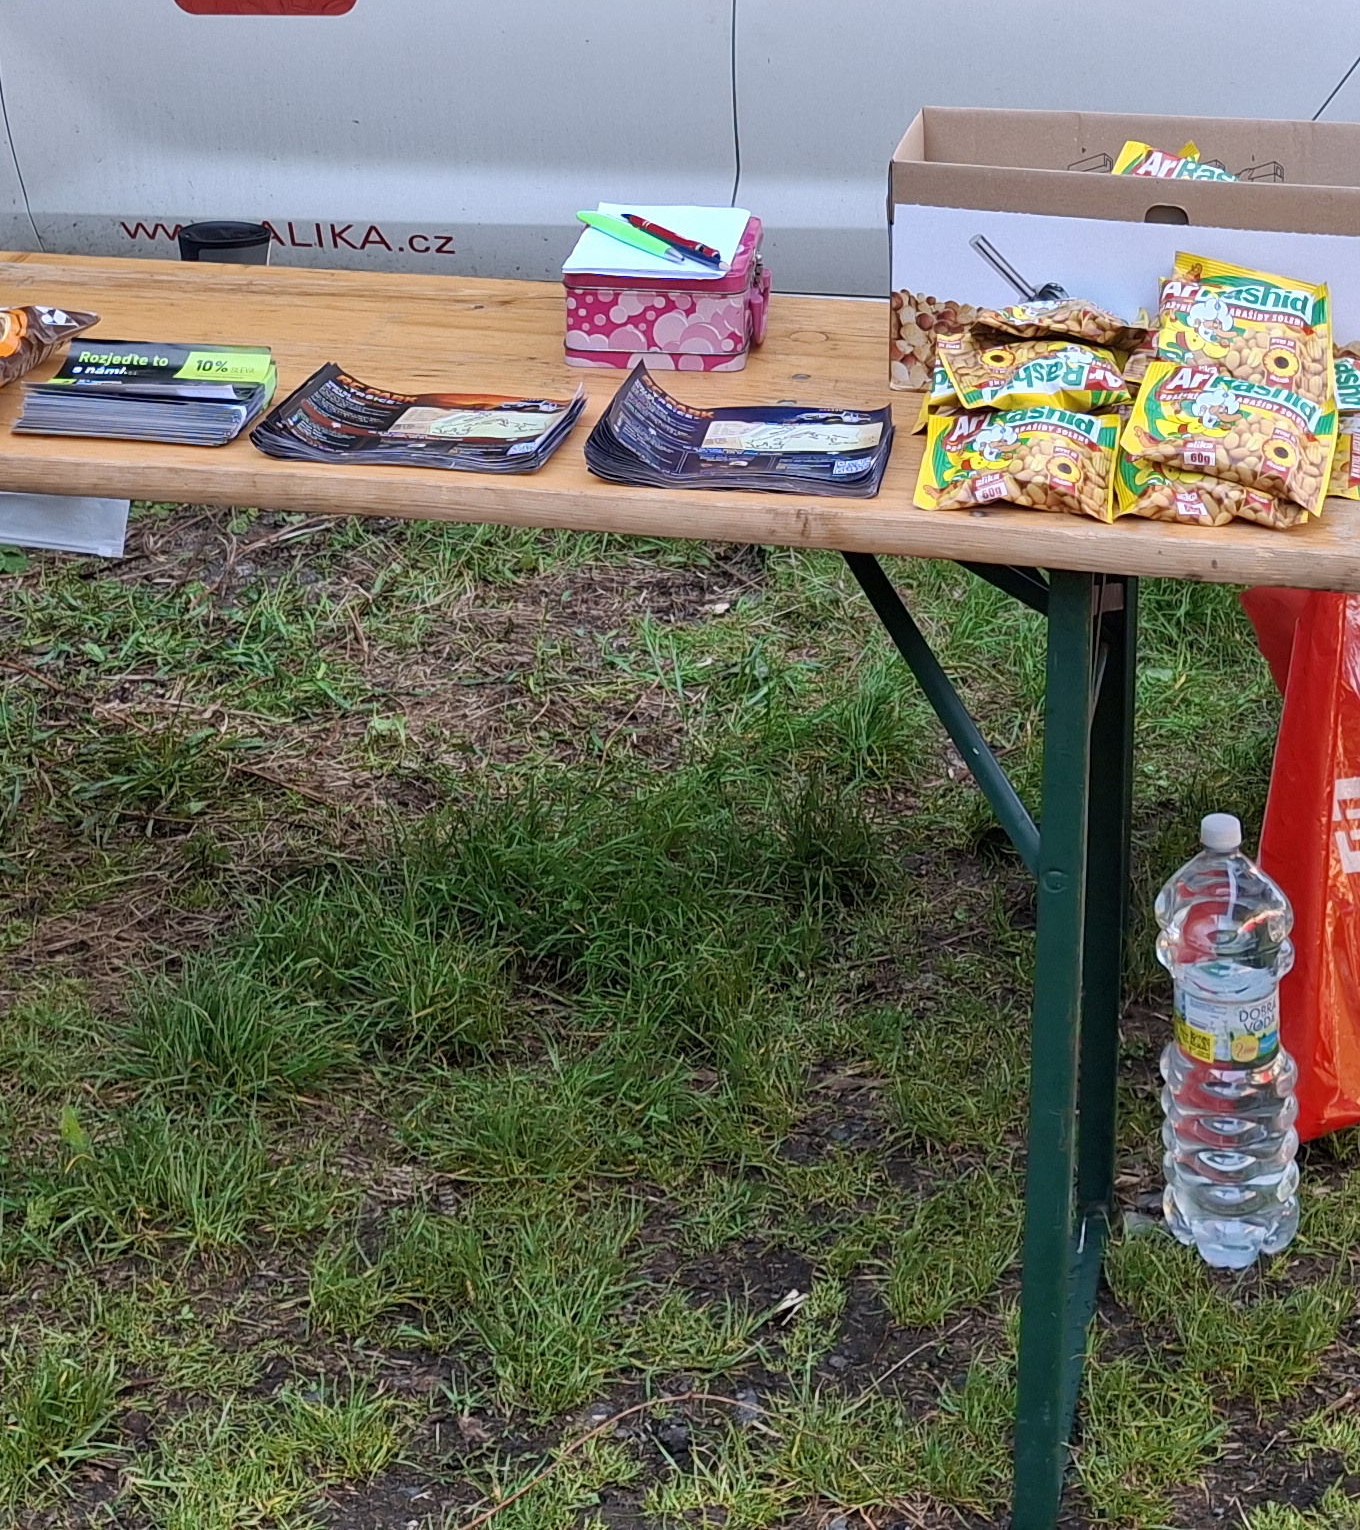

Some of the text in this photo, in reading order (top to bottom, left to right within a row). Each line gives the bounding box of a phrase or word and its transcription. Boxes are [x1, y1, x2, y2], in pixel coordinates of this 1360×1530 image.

[153, 355, 170, 367] to
[196, 359, 228, 374] 10%
[1190, 452, 1211, 466] 60g
[981, 485, 1004, 500] 60g
[1243, 1015, 1276, 1033] VODA
